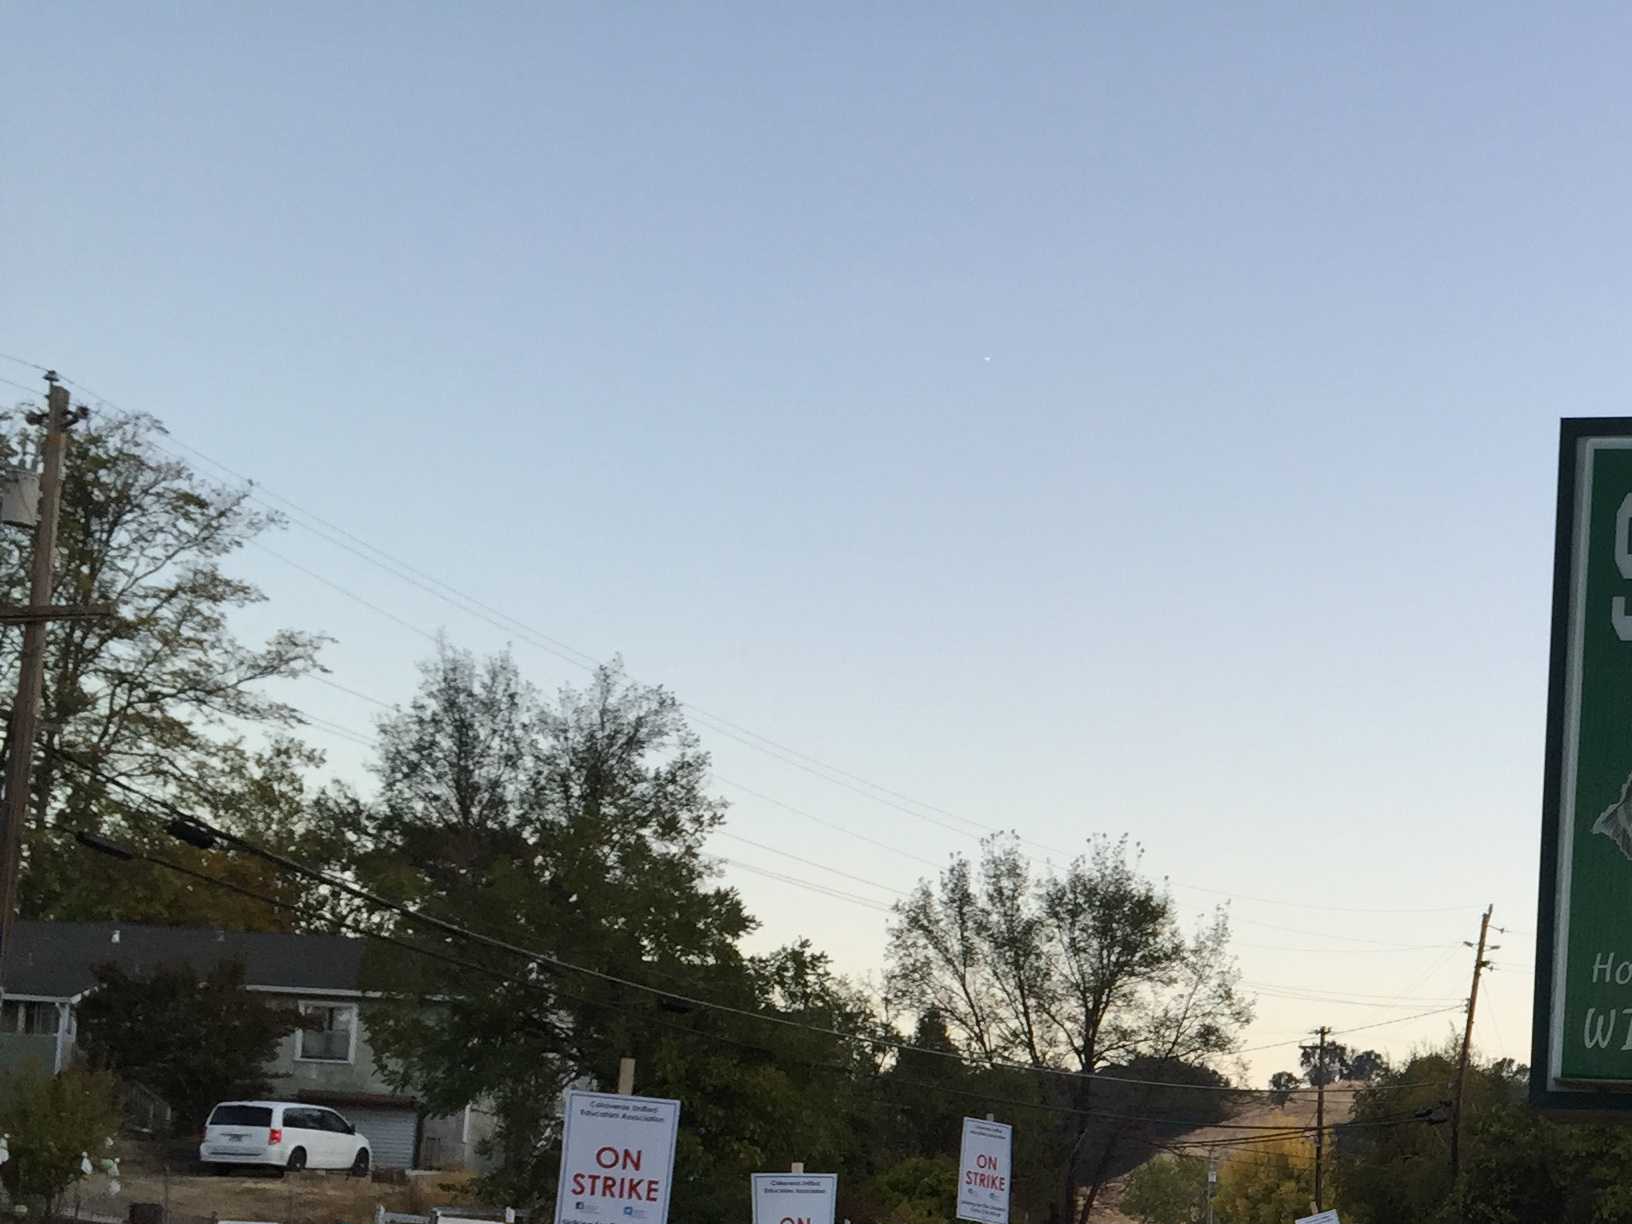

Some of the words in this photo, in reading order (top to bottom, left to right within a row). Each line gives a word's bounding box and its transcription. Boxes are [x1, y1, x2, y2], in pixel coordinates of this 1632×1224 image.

[595, 1145, 643, 1172] ON
[976, 1154, 998, 1171] ON
[571, 1172, 660, 1203] STRIKE
[965, 1170, 1006, 1192] STRIKE
